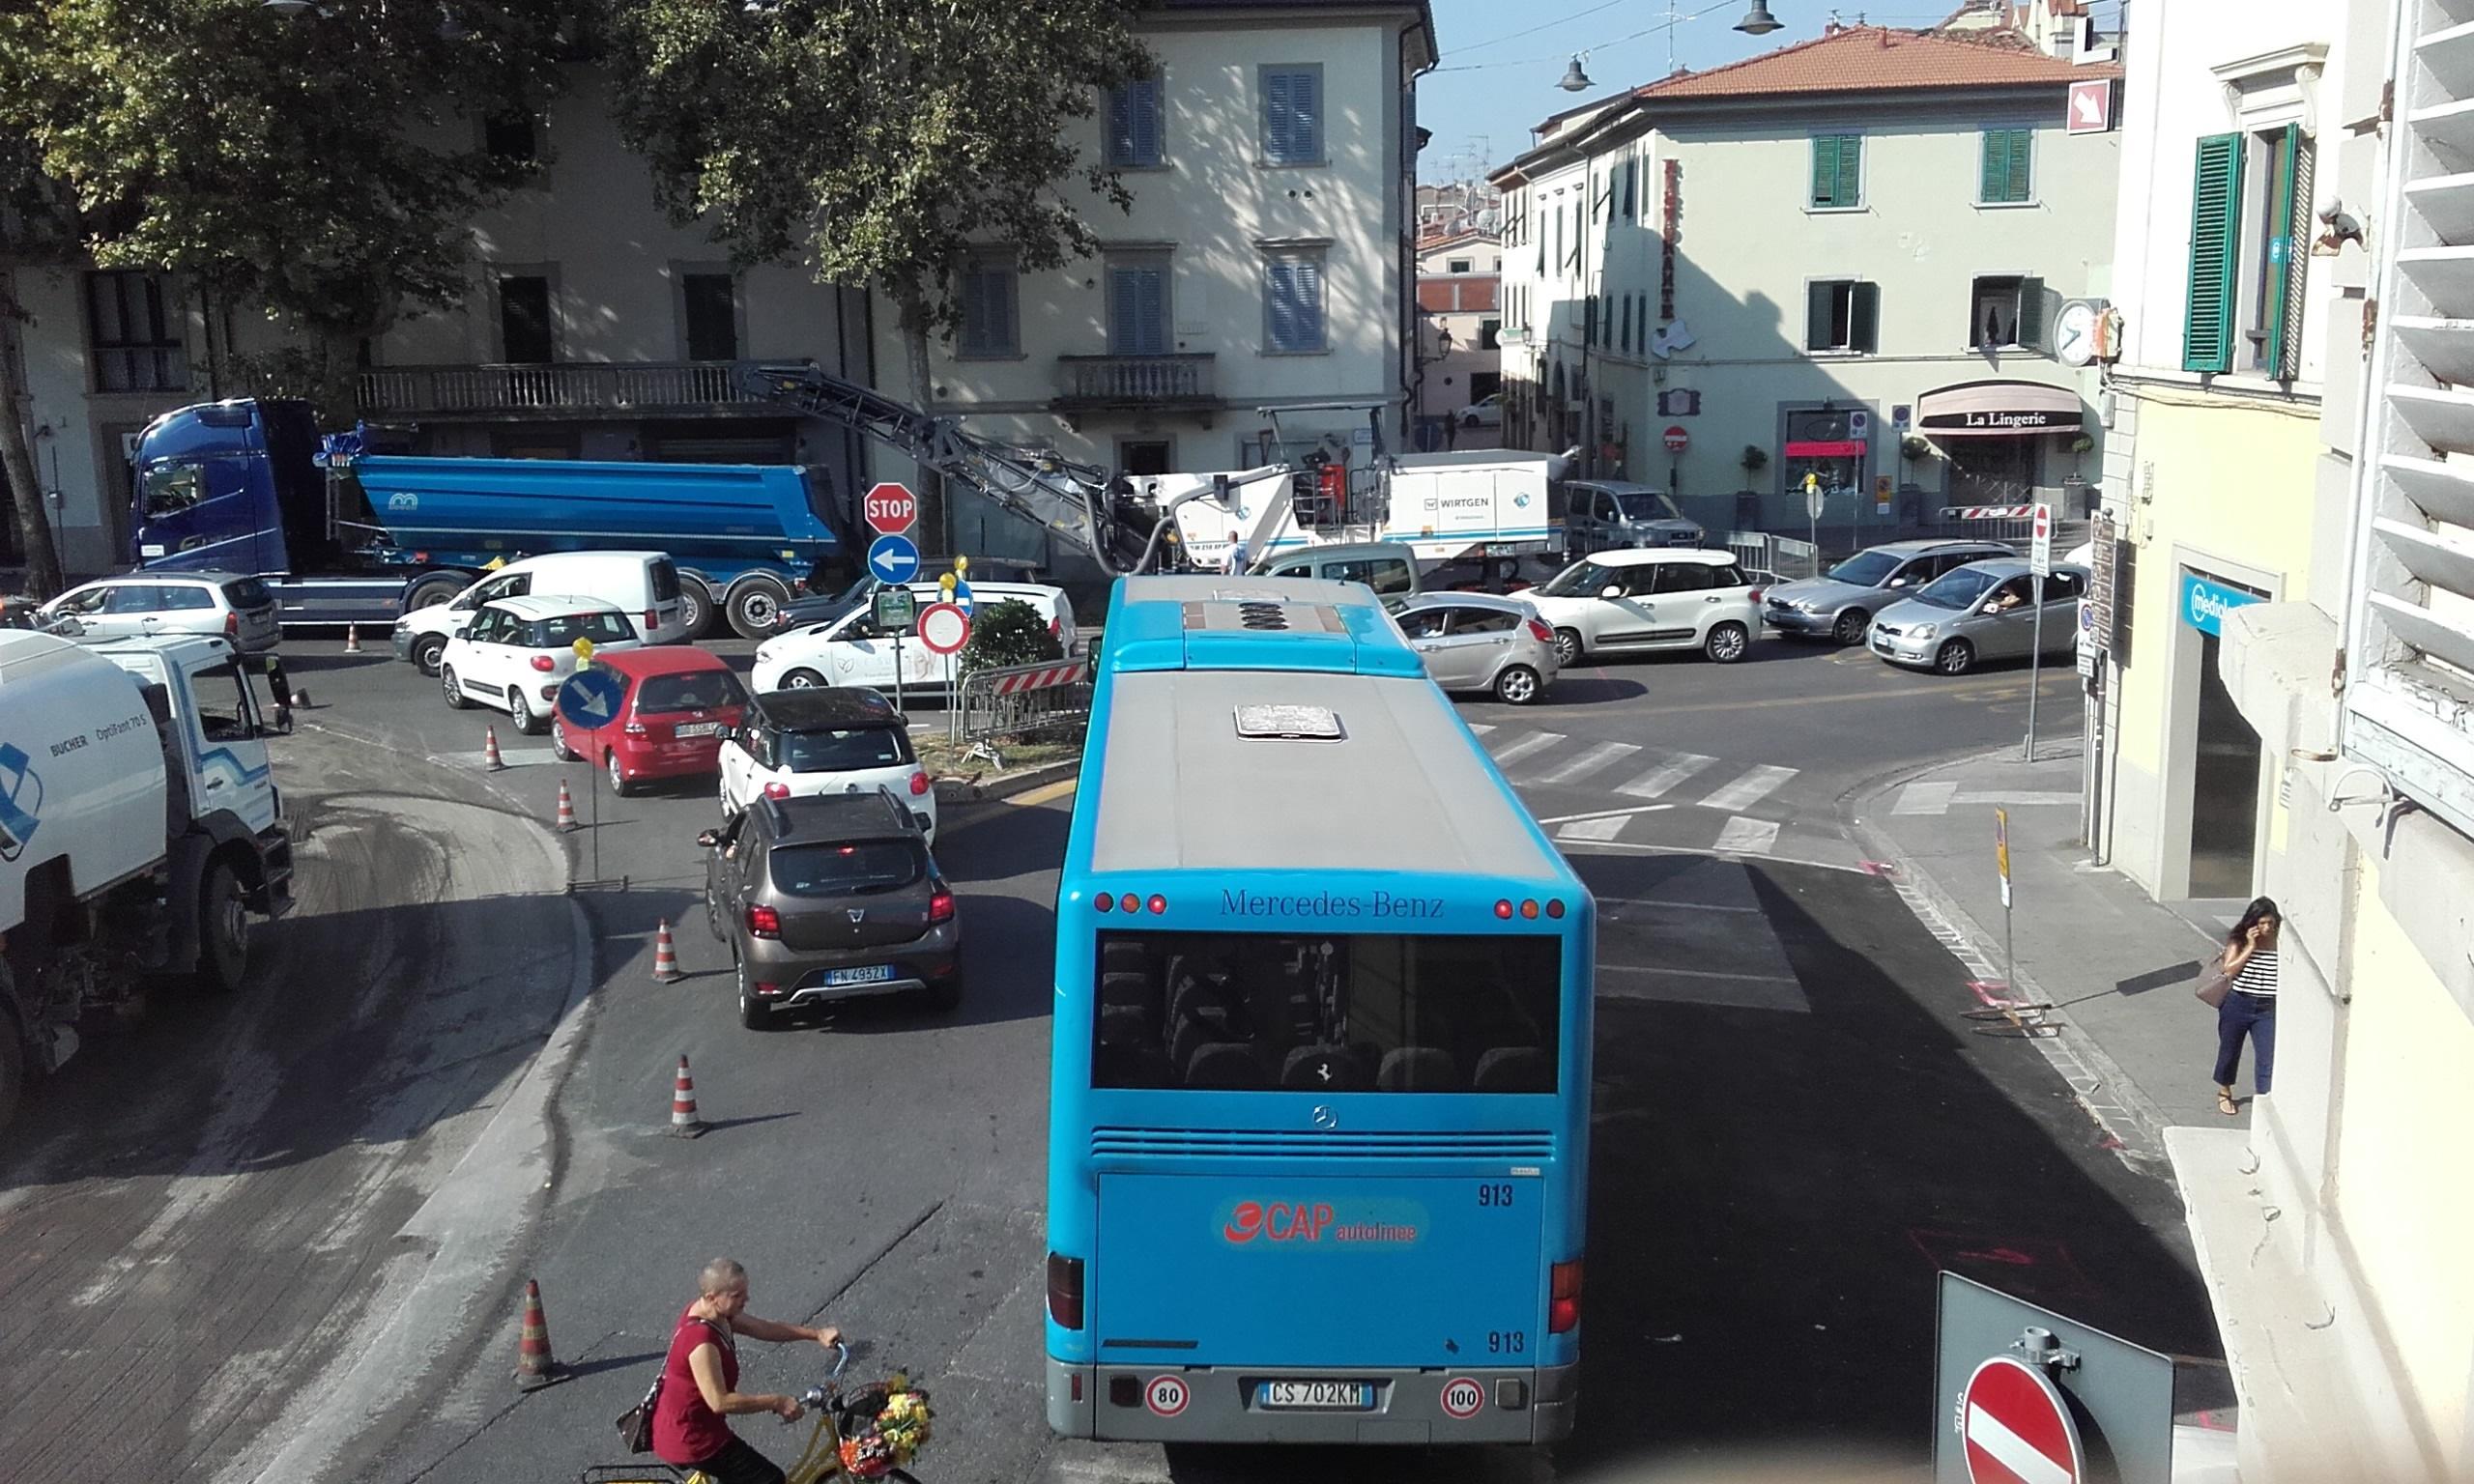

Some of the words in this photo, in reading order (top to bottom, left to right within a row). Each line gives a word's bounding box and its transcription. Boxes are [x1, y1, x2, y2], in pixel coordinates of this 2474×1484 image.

[1966, 413, 1984, 426] La
[1989, 412, 2046, 427] Lingerie
[868, 499, 913, 519] STOP
[1440, 498, 1489, 508] WIRTGEN
[50, 734, 89, 757] BUCHER
[95, 720, 131, 741] OptiFant
[129, 716, 141, 728] 70
[140, 714, 148, 726] S
[1221, 888, 1444, 919] Mercedes-Benz
[1479, 1184, 1513, 1208] 913
[1337, 1221, 1417, 1241] autolinee
[1489, 1330, 1524, 1354] 913
[1159, 1387, 1179, 1404] 80
[1273, 1383, 1295, 1403] CS
[1302, 1383, 1360, 1404] 702KM
[1451, 1389, 1477, 1406] 100
